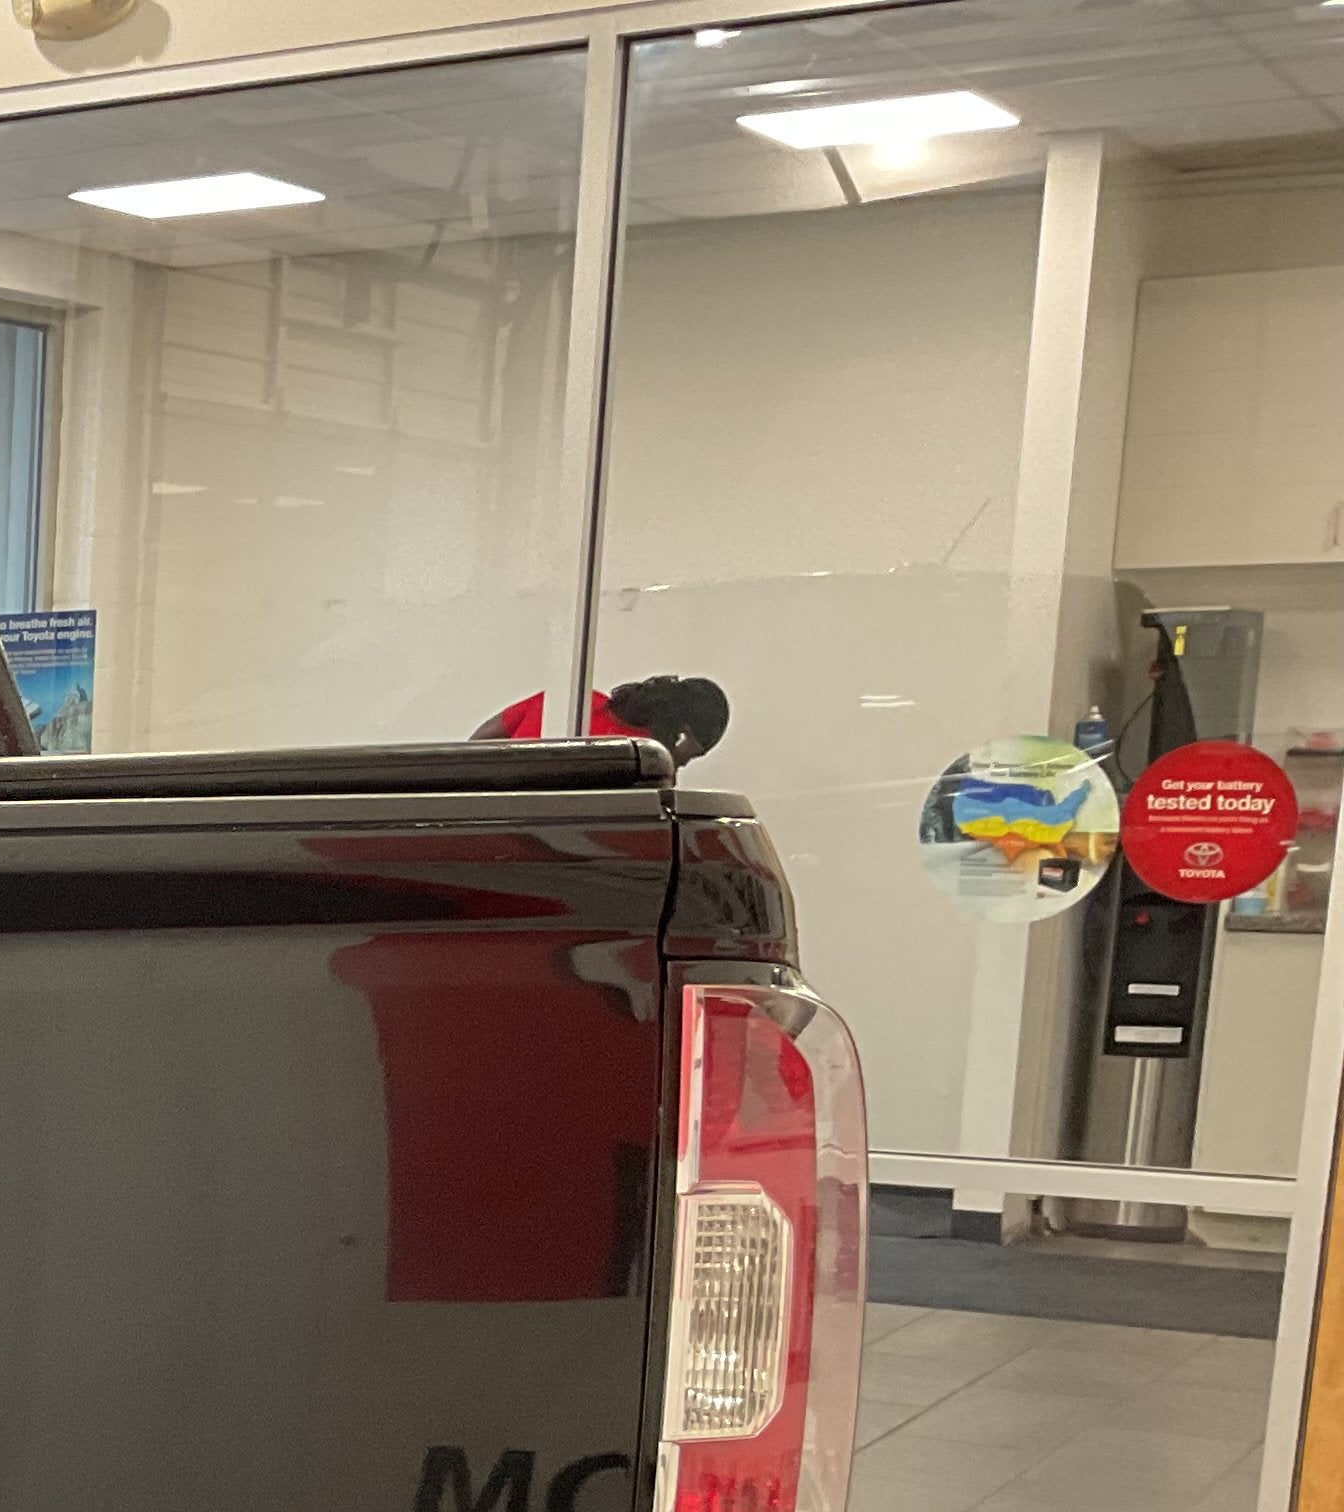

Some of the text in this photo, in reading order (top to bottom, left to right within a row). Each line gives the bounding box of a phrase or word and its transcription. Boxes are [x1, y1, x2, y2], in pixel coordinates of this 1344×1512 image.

[9, 619, 48, 630] breathe
[50, 617, 75, 628] fresh
[22, 631, 55, 644] Toyota
[57, 629, 94, 642] engine.
[1162, 779, 1263, 793] Get your battery
[1147, 794, 1275, 815] tested today
[1178, 868, 1226, 879] TOYOTA
